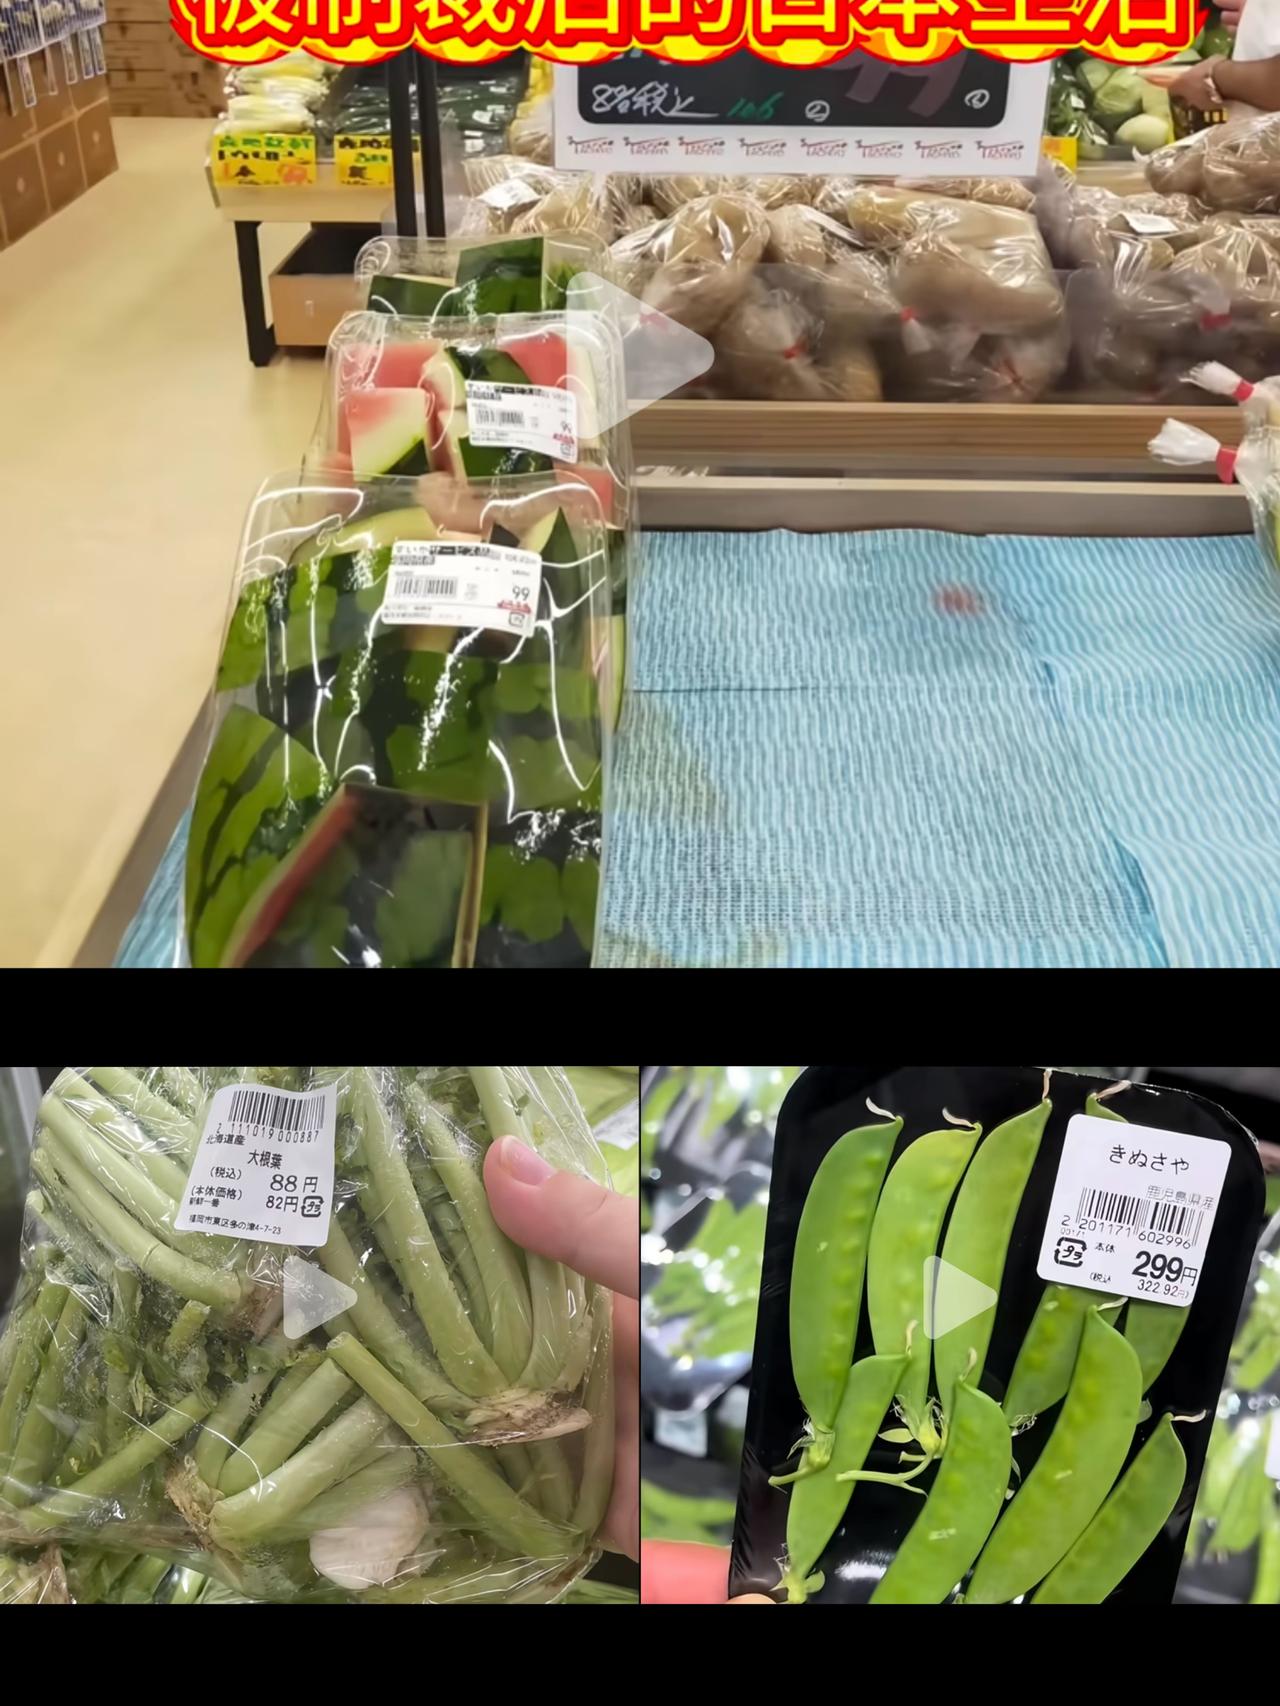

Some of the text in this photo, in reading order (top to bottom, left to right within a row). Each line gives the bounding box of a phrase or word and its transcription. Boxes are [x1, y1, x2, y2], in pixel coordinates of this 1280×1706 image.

[512, 585, 530, 601] 99
[206, 1134, 246, 1146] 北海道産
[247, 1149, 283, 1170] 大根葉
[1109, 1144, 1190, 1175] きぬさや
[210, 1166, 242, 1180] (税込)
[266, 1195, 299, 1213] 82円
[1138, 1231, 1191, 1250] 602996
[1132, 1250, 1198, 1286] 299円
